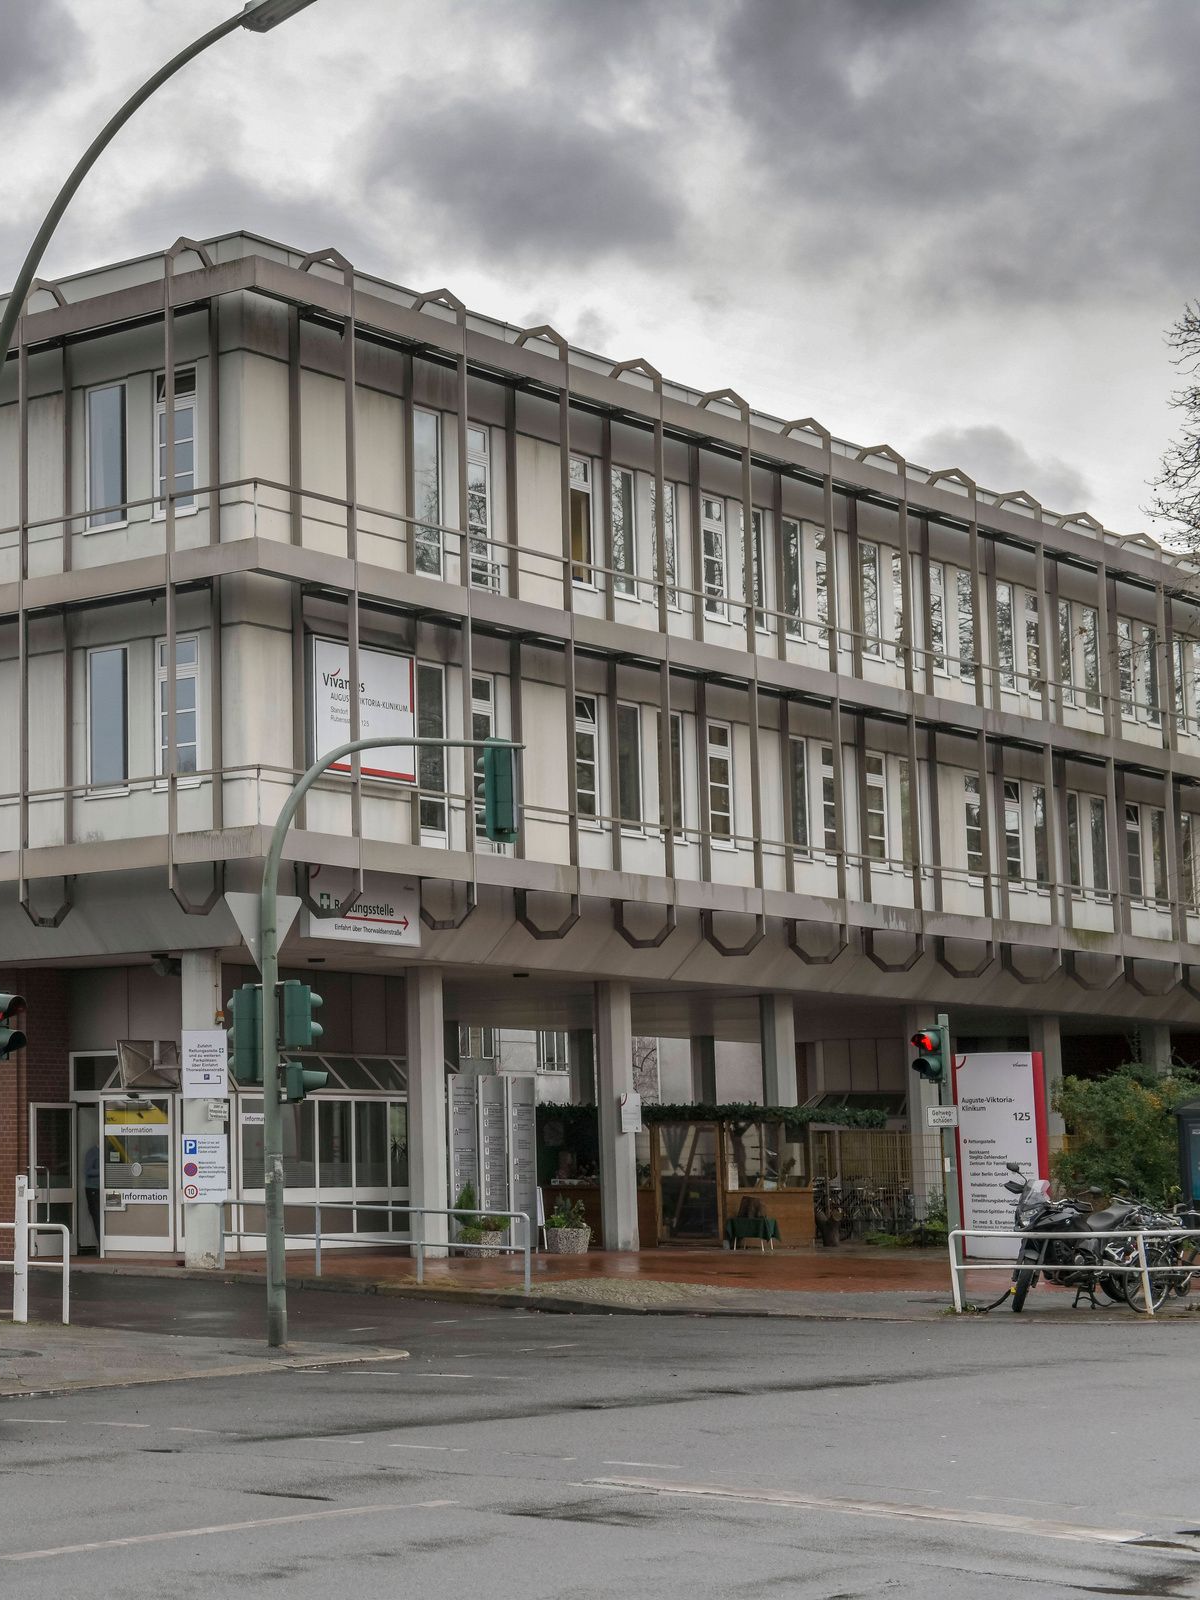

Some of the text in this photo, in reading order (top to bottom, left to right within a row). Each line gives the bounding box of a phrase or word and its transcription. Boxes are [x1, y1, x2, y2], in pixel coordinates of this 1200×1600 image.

[334, 899, 394, 917] Rungsstelle
[363, 926, 402, 936] Thorwaldsenstraße
[961, 1097, 1015, 1105] Auguste-Viktoria-
[932, 1115, 953, 1123] schäden
[1012, 1112, 1031, 1121] 125
[122, 1192, 168, 1201] Information
